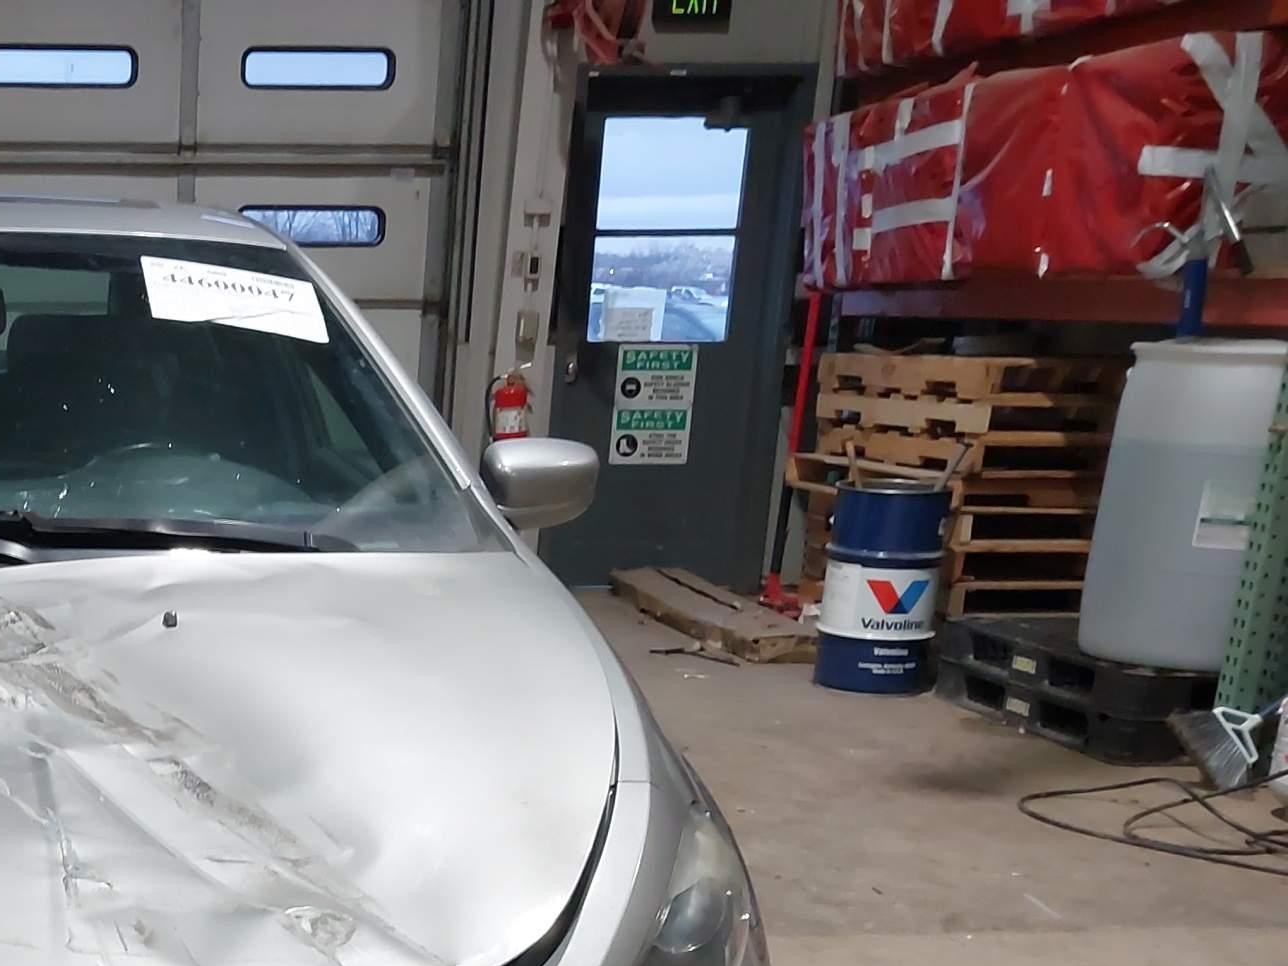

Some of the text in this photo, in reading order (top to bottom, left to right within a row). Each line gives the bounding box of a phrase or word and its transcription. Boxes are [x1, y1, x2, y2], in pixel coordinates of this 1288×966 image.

[625, 350, 690, 364] SAFETY
[636, 360, 681, 369] FIRST
[620, 410, 684, 425] SAFETY
[631, 420, 674, 429] FIRST
